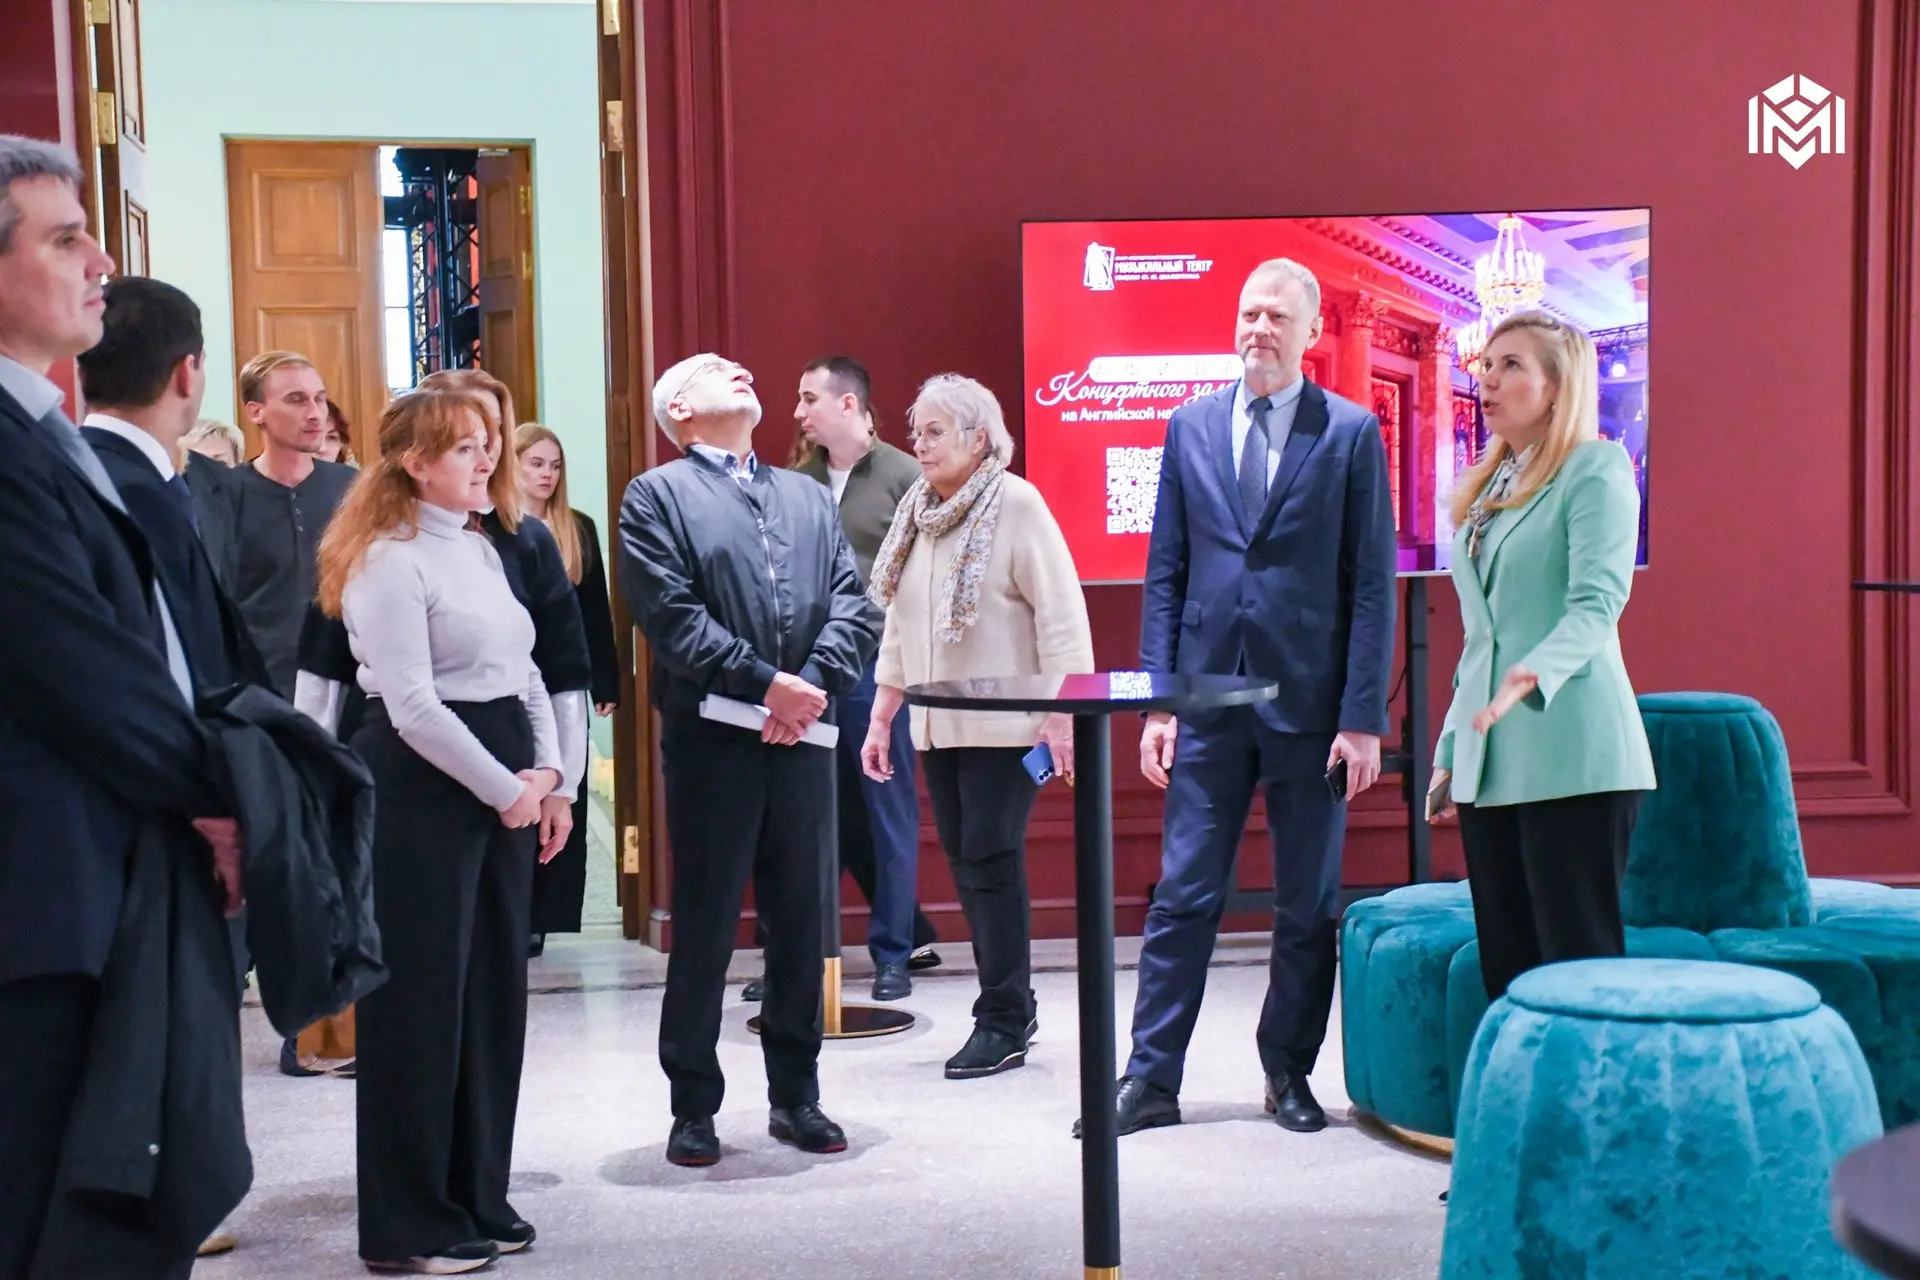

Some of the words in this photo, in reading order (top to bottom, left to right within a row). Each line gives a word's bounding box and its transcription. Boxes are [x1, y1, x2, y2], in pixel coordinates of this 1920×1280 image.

[1185, 259, 1213, 273] ТЕАТР
[1035, 366, 1187, 406] Концертного
[1061, 411, 1077, 422] на
[1079, 406, 1155, 422] Английской
